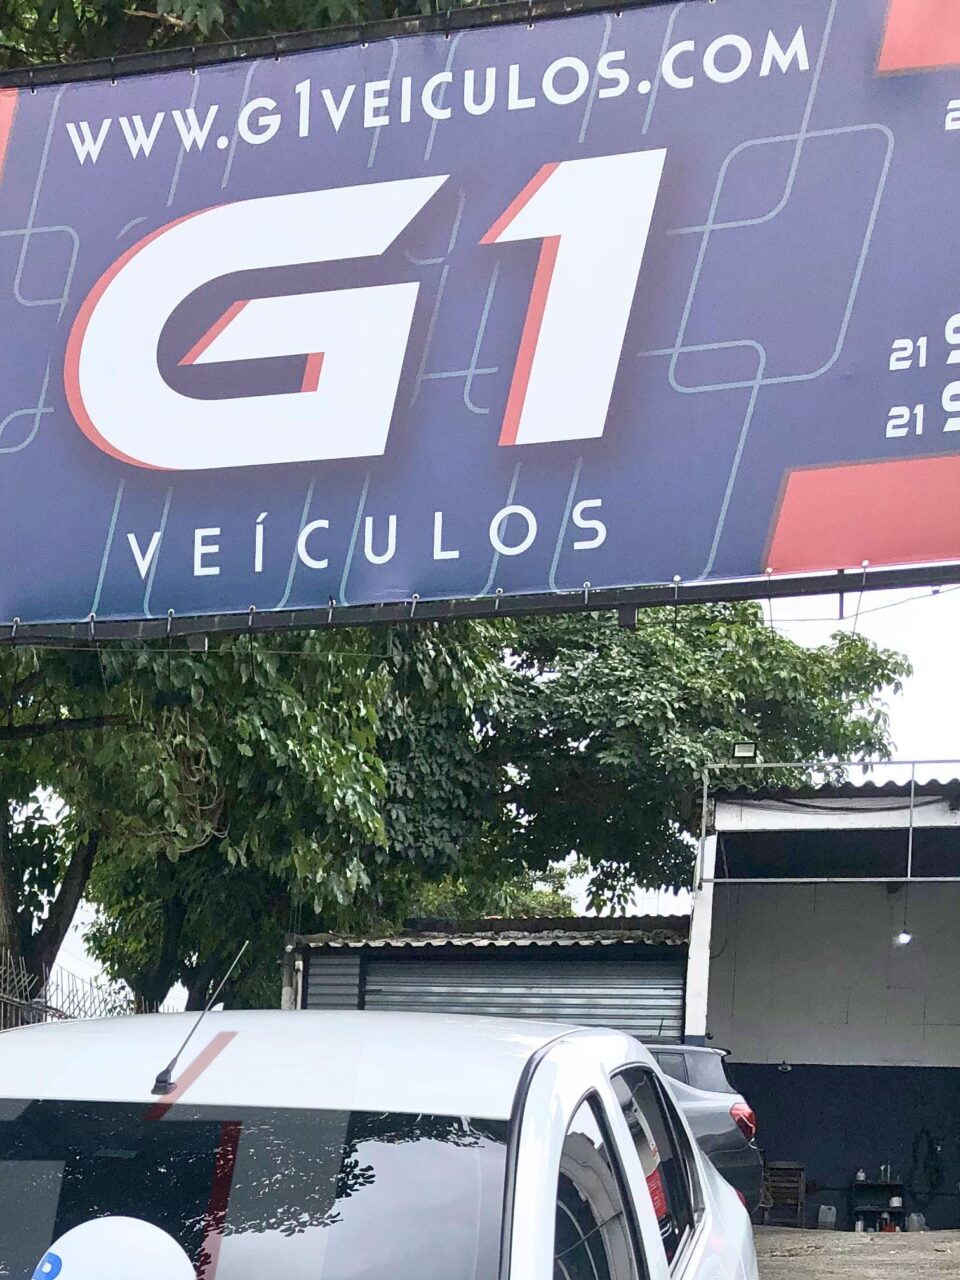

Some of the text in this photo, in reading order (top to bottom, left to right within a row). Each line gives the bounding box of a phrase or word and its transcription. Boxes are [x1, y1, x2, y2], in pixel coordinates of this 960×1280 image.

[66, 24, 809, 165] WWW.G1VEICULOS.COM
[63, 147, 668, 471] G1
[888, 336, 928, 372] 21
[885, 403, 924, 439] 21
[127, 498, 608, 579] VEÍCULOS
